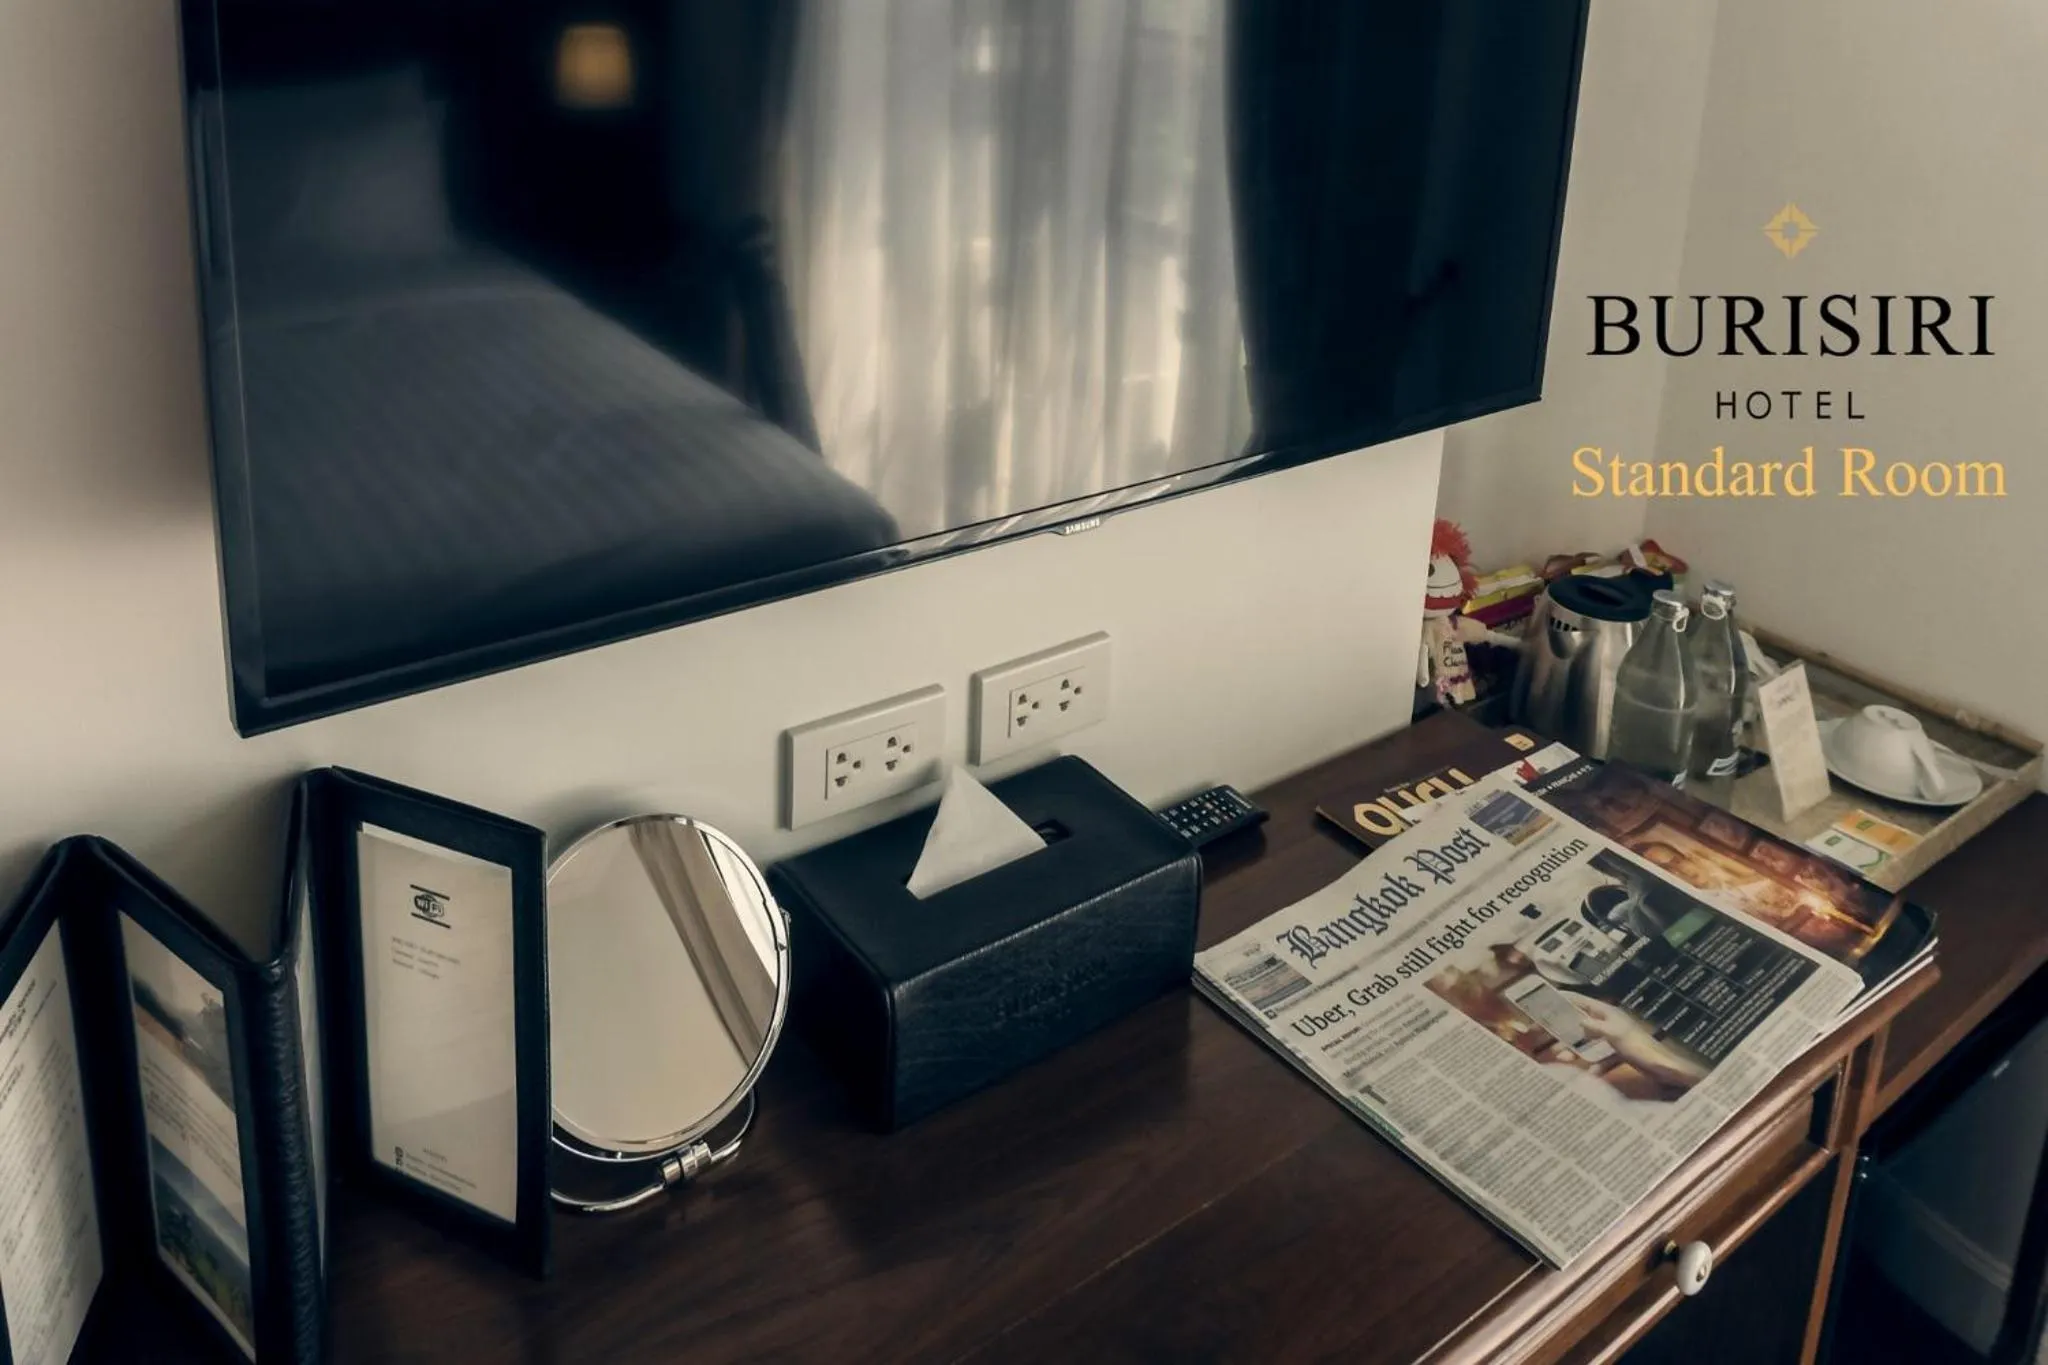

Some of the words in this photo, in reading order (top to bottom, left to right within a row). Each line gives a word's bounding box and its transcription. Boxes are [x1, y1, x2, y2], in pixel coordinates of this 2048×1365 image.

[1276, 872, 1425, 970] Bangkok
[1404, 827, 1490, 886] Post
[1290, 1002, 1357, 1038] Uber,
[1347, 973, 1400, 1007] Grab
[1395, 946, 1437, 980] still
[1426, 918, 1478, 955] fight
[1467, 899, 1500, 925] for
[1498, 837, 1590, 906] recognition
